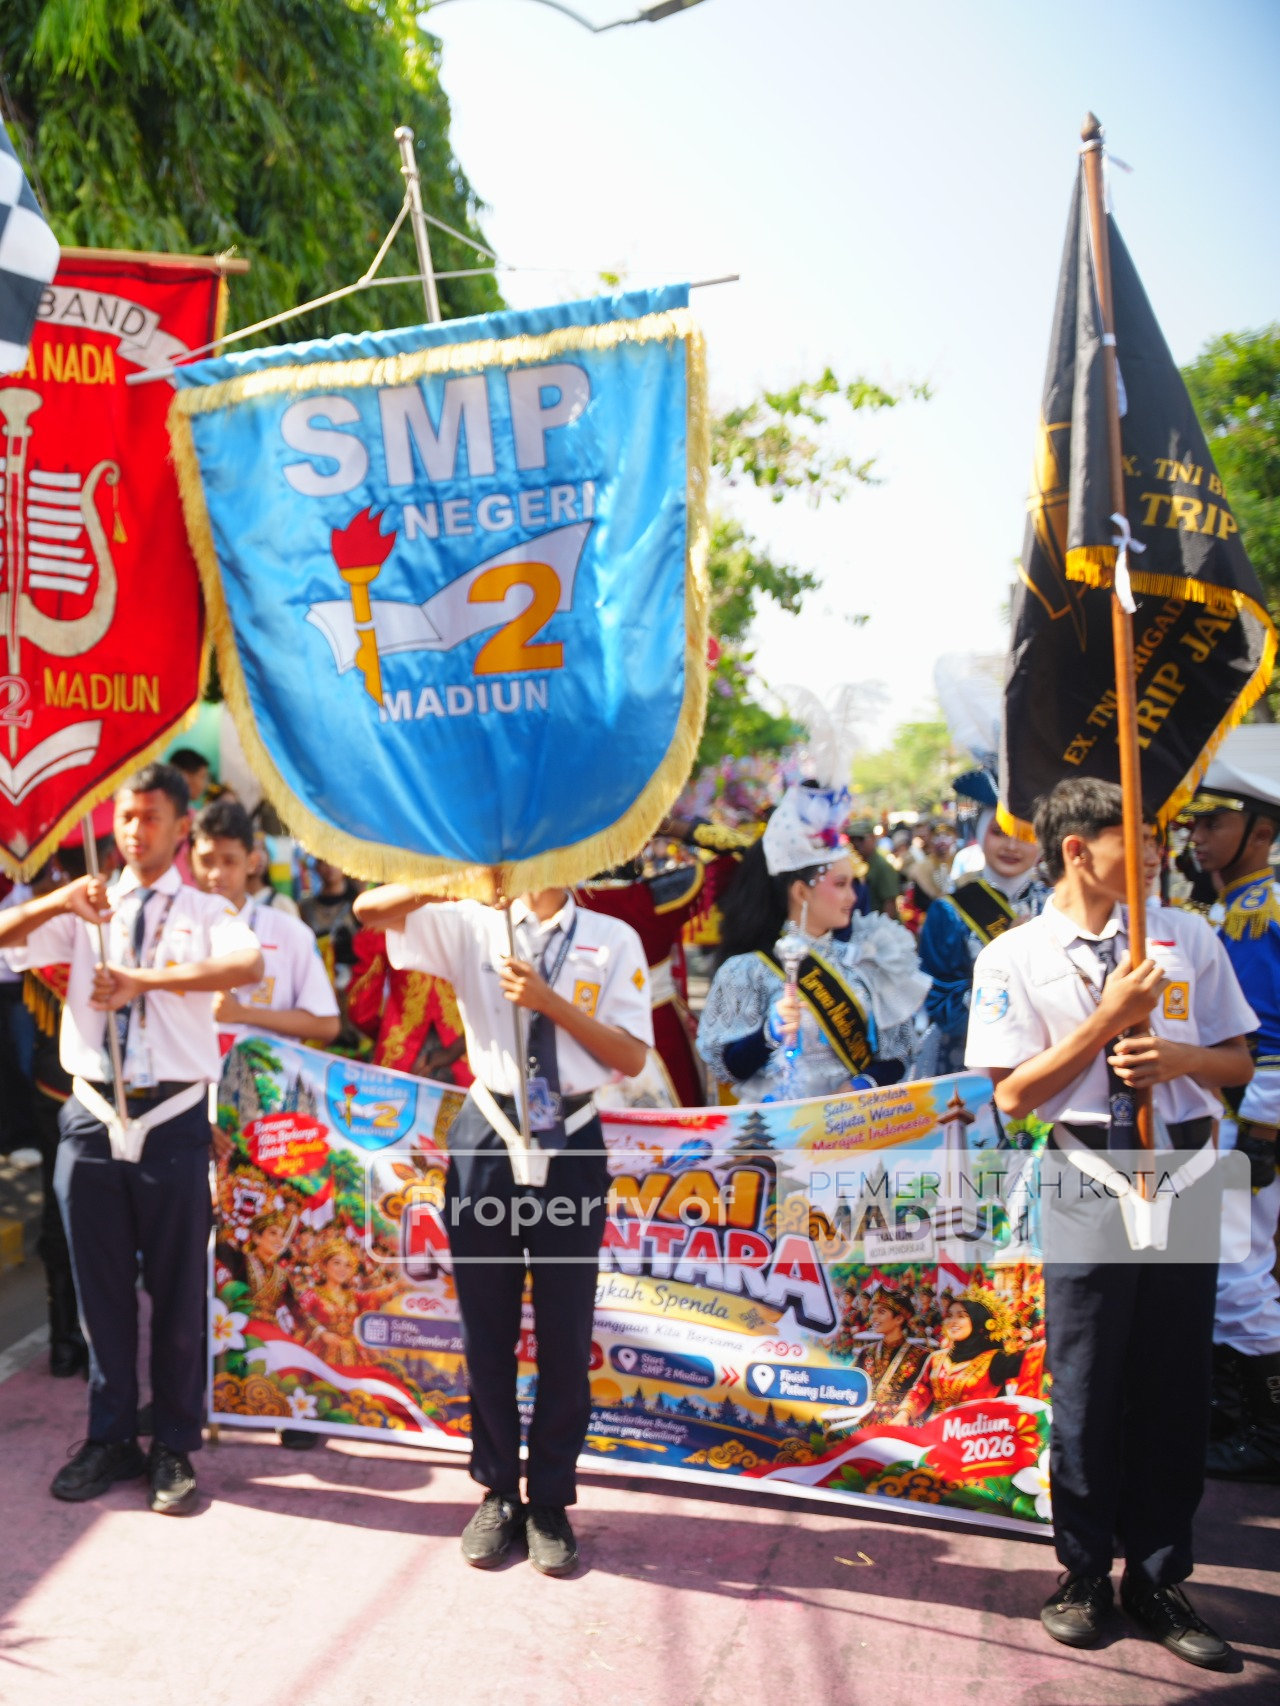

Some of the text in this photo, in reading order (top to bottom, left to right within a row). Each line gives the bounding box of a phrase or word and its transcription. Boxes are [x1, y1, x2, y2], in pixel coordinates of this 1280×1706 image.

[42, 341, 117, 386] NADA
[280, 363, 591, 497] SMP
[1154, 457, 1204, 486] TNI
[403, 480, 597, 541] NEGERI
[1140, 492, 1239, 540] TRIP
[467, 561, 564, 677] 2
[44, 667, 160, 714] MADIUN
[379, 678, 549, 724] MADIUN
[373, 1103, 399, 1129] 2
[824, 1088, 909, 1118] Satu Sekolah
[825, 1101, 915, 1135] Sejuta Warna
[811, 1115, 932, 1154] Merajut Indonesia
[650, 1285, 730, 1321] Spenda
[780, 1369, 809, 1384] Finish
[780, 1381, 858, 1404] Patung Liberty
[941, 1415, 1016, 1442] Madiun,
[961, 1436, 1016, 1463] 2026
